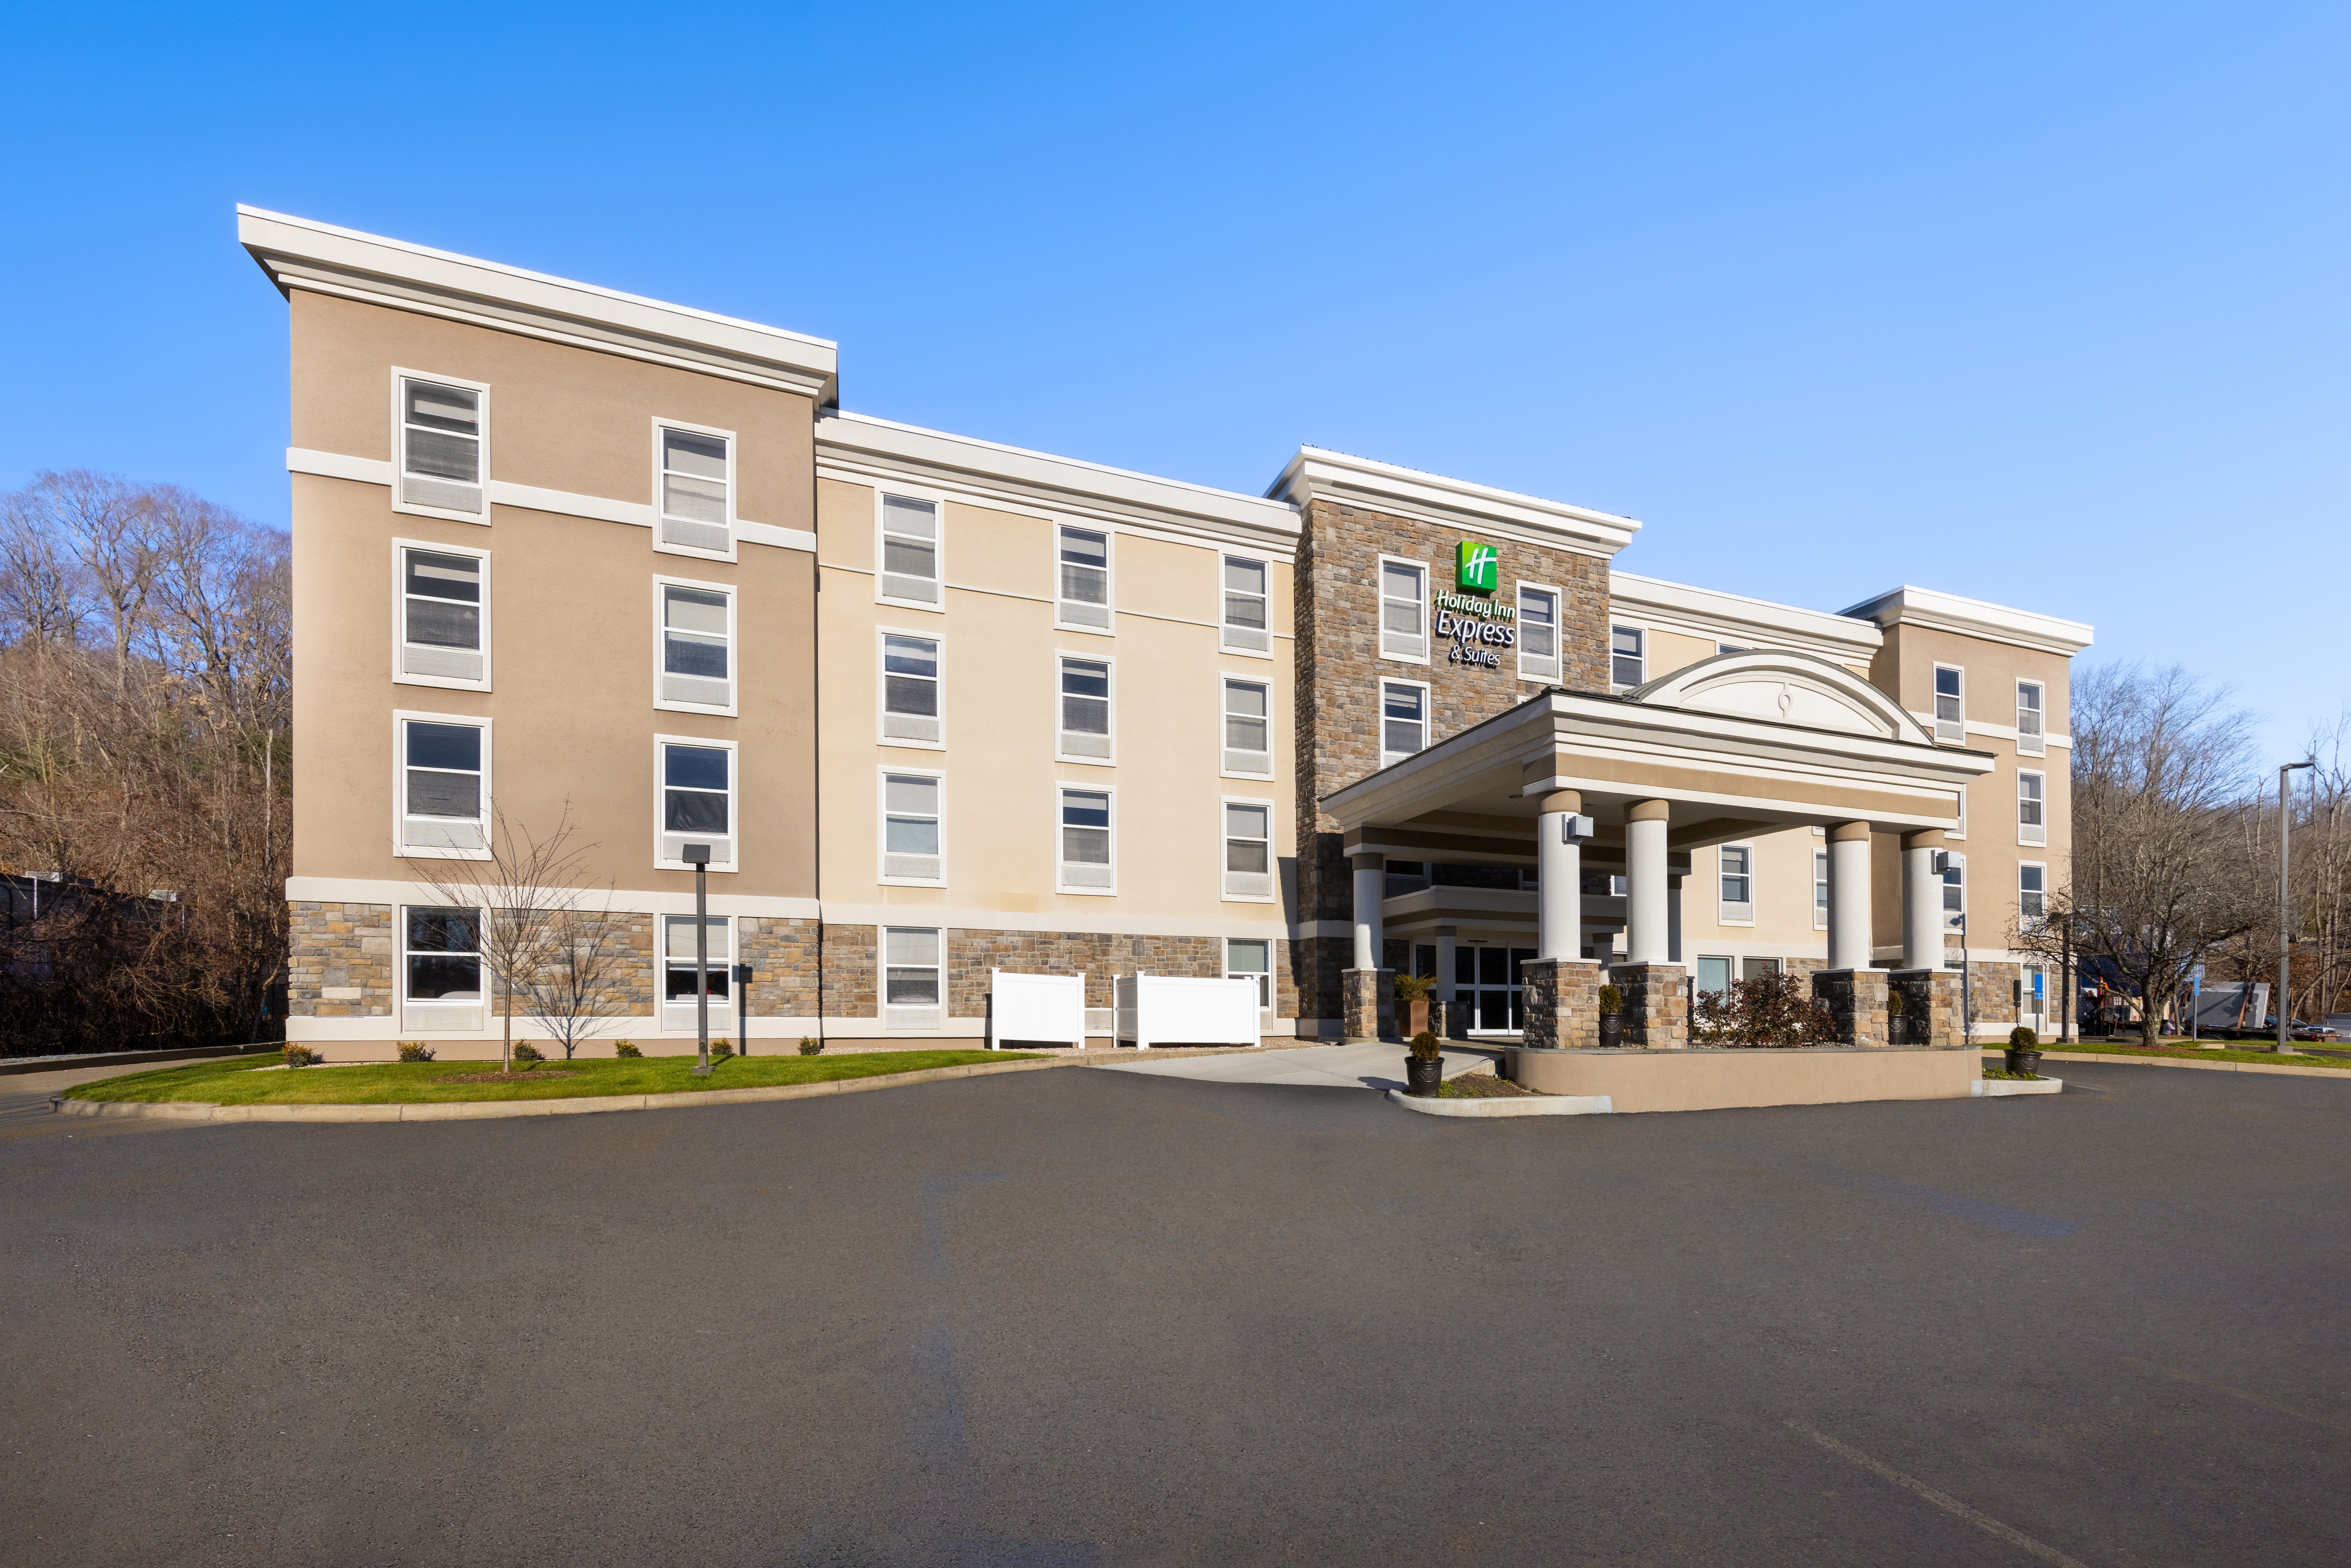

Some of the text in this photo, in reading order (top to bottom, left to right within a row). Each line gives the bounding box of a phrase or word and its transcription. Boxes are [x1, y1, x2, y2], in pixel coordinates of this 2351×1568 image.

[1437, 589, 1515, 618] Holiday Inn
[1438, 610, 1515, 644] Express
[1451, 645, 1500, 665] & Suites
